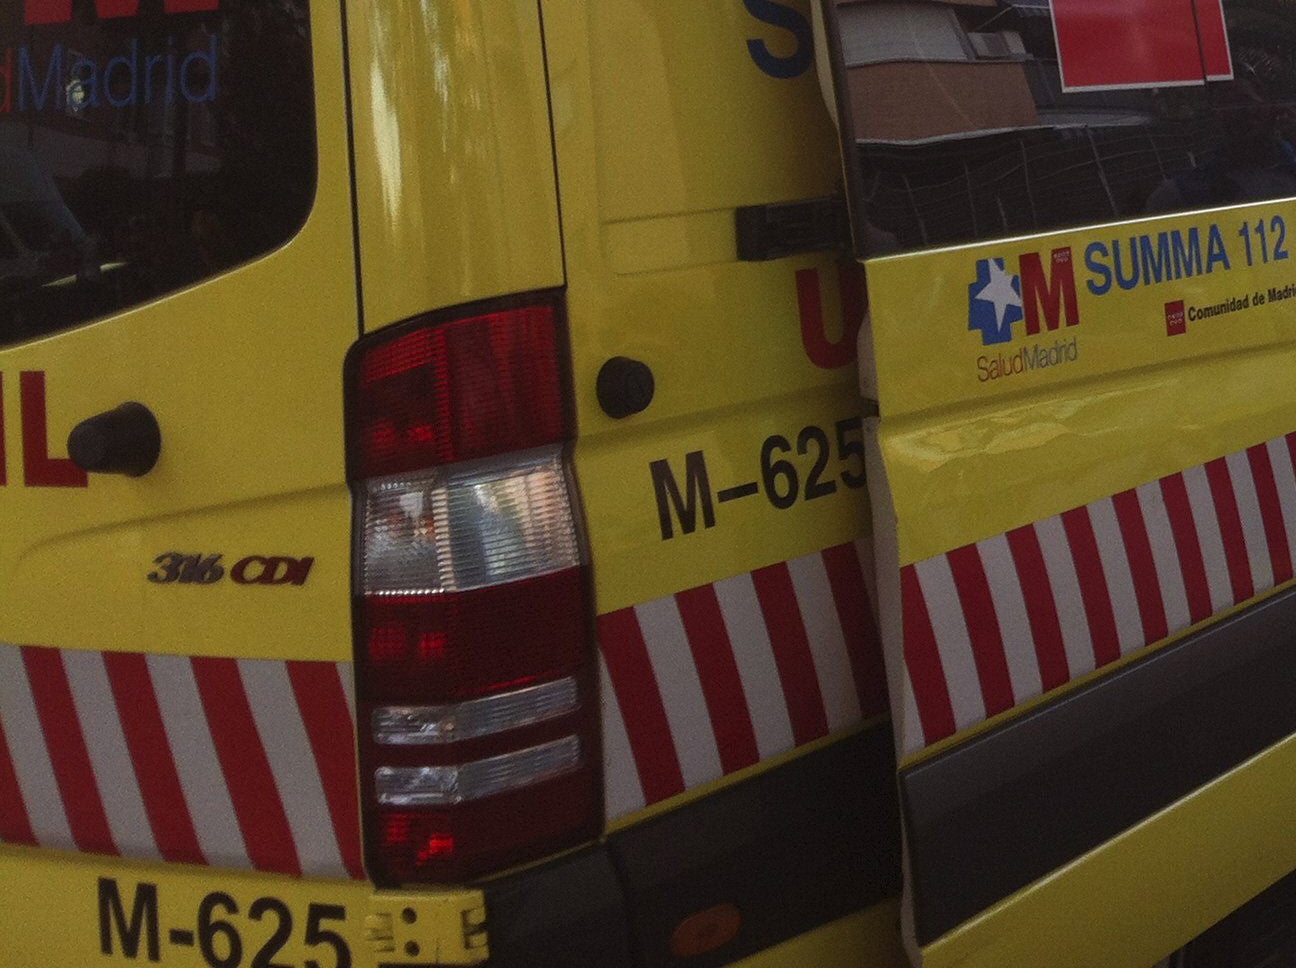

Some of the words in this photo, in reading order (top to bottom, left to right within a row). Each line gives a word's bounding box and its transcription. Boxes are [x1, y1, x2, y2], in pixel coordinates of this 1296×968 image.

[1085, 223, 1231, 296] SUMMA
[1238, 215, 1289, 267] 112
[1188, 295, 1250, 322] Comunidad
[1252, 292, 1265, 306] de
[976, 336, 1079, 383] SaludMadrid
[0, 370, 89, 488] L
[648, 416, 868, 541] M-625
[147, 551, 225, 584] 316
[230, 554, 315, 586] CDI
[97, 875, 352, 968] M-625
